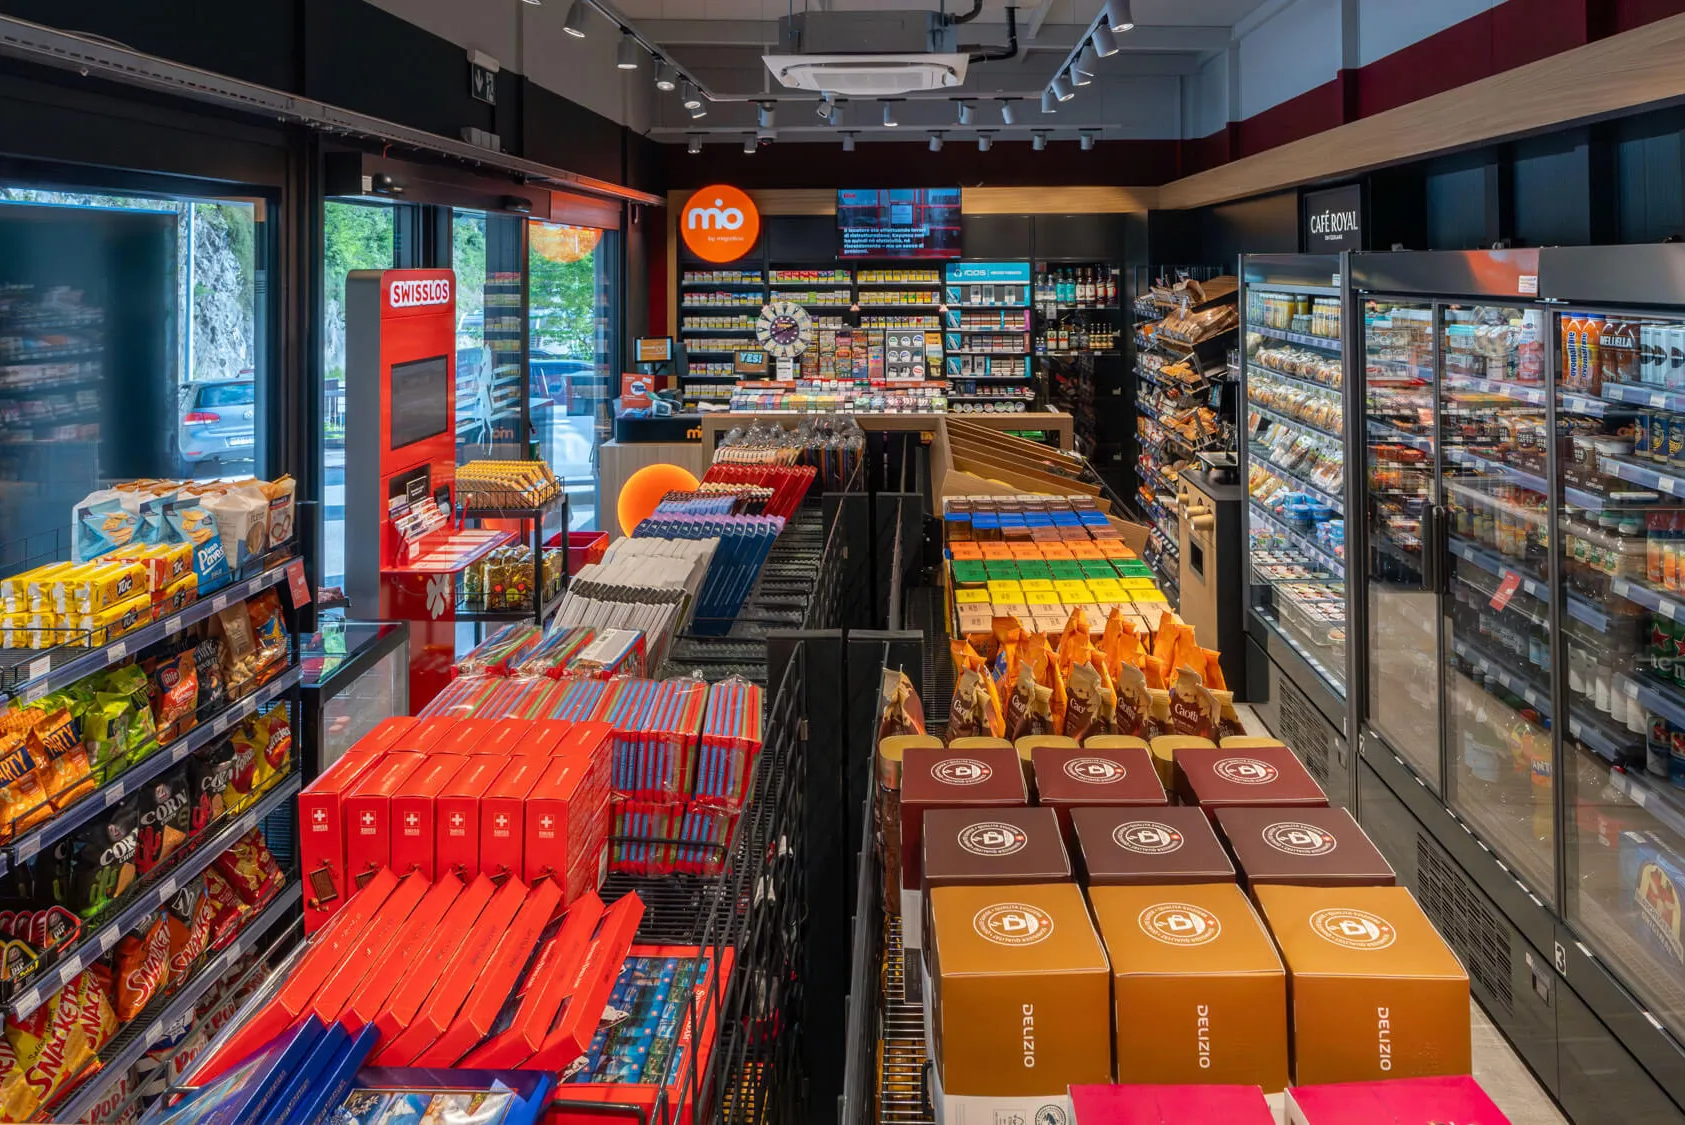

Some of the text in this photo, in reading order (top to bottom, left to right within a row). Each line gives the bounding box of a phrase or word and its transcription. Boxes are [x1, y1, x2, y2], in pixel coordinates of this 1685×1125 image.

[688, 198, 744, 230] mio
[1310, 209, 1358, 234] CAFÉ ROYAL
[393, 282, 448, 303] SWISSLOS
[739, 352, 764, 364] YES!
[686, 425, 702, 440] mi
[0, 749, 28, 782] ARTY
[1556, 945, 1565, 971] 3
[1022, 1003, 1035, 1068] DELIZIO
[1197, 1004, 1210, 1069] DELIZIO
[1377, 1007, 1391, 1071] DELIZIO
